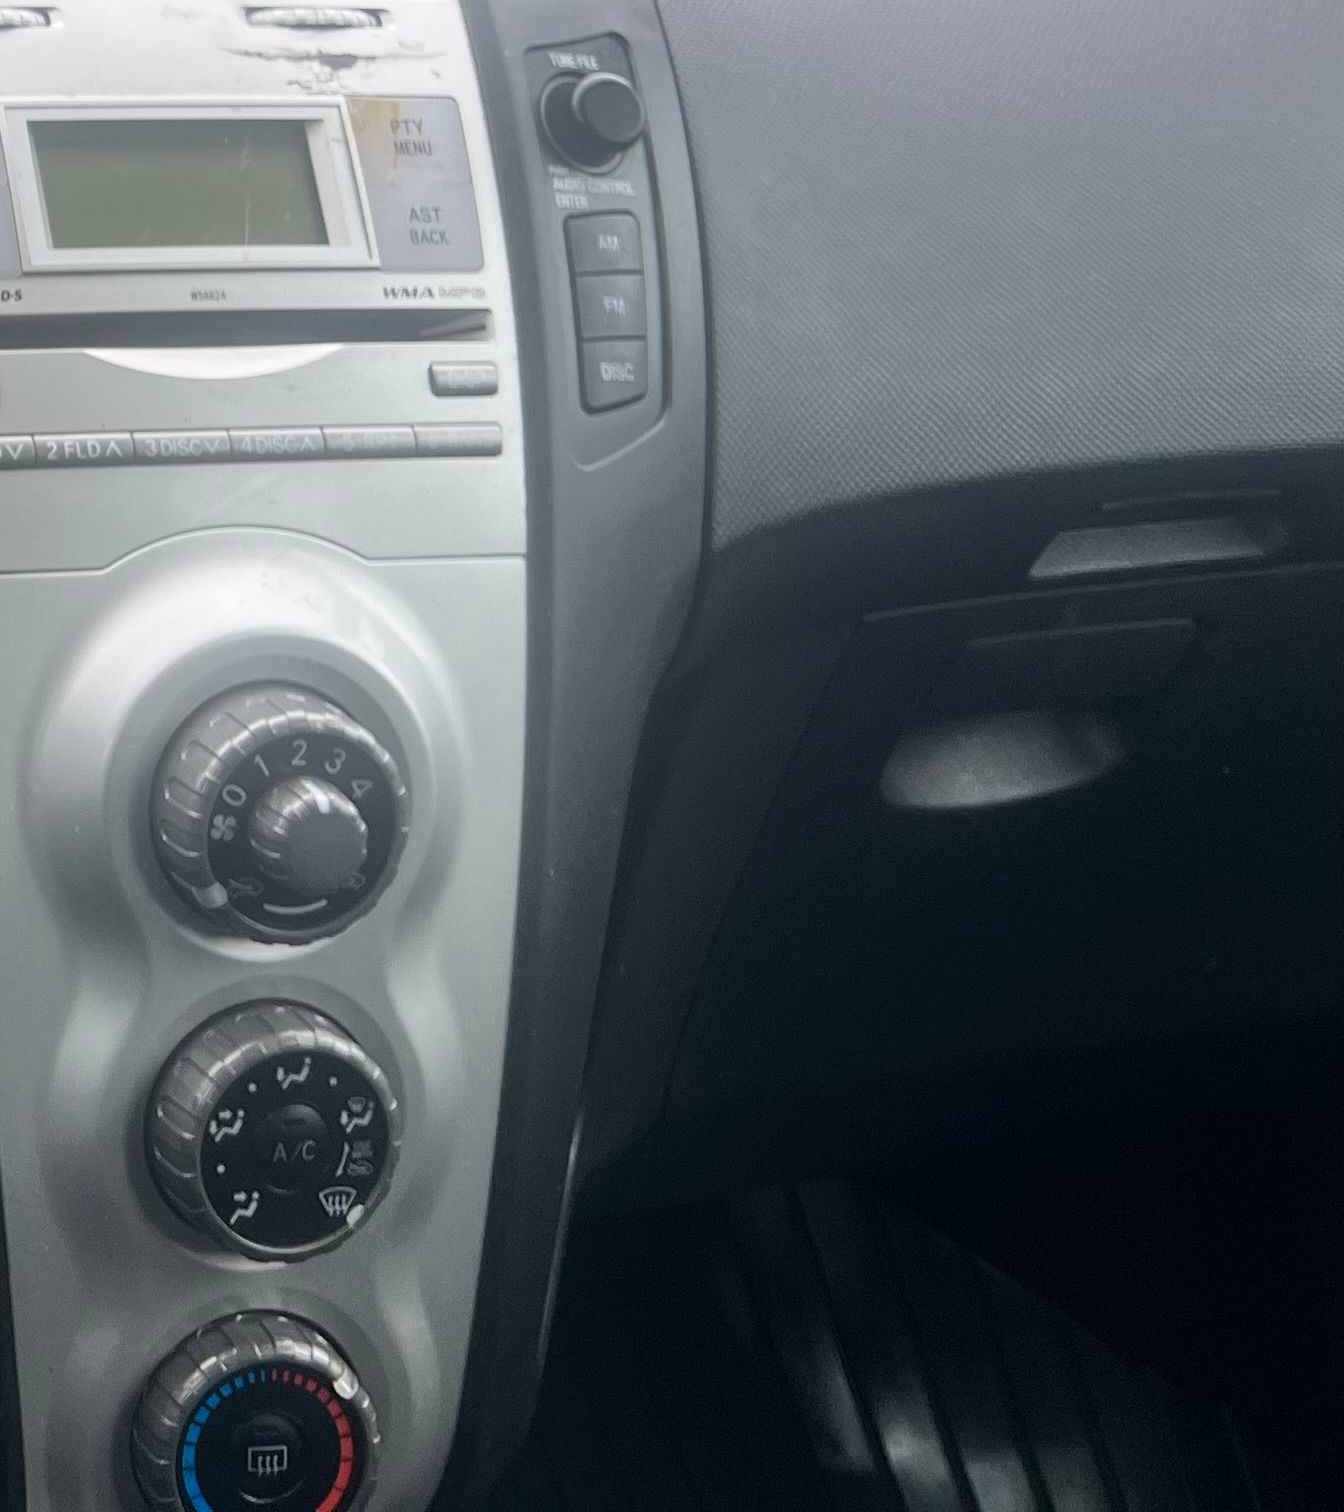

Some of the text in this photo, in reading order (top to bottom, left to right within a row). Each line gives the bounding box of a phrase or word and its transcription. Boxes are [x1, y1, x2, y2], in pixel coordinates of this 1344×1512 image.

[390, 118, 423, 135] PTY
[393, 140, 433, 157] MENU
[409, 205, 441, 223] AST
[409, 229, 449, 246] BACK
[599, 235, 620, 252] AM
[382, 286, 435, 300] WMA
[602, 296, 626, 316] FM
[599, 361, 635, 382] DISC
[46, 440, 101, 461] 2 FLD
[145, 438, 204, 458] 3 DISC
[240, 435, 297, 455] 4 DISC
[222, 739, 373, 807] 0 1 2 3 4
[272, 1140, 316, 1162] A/C
